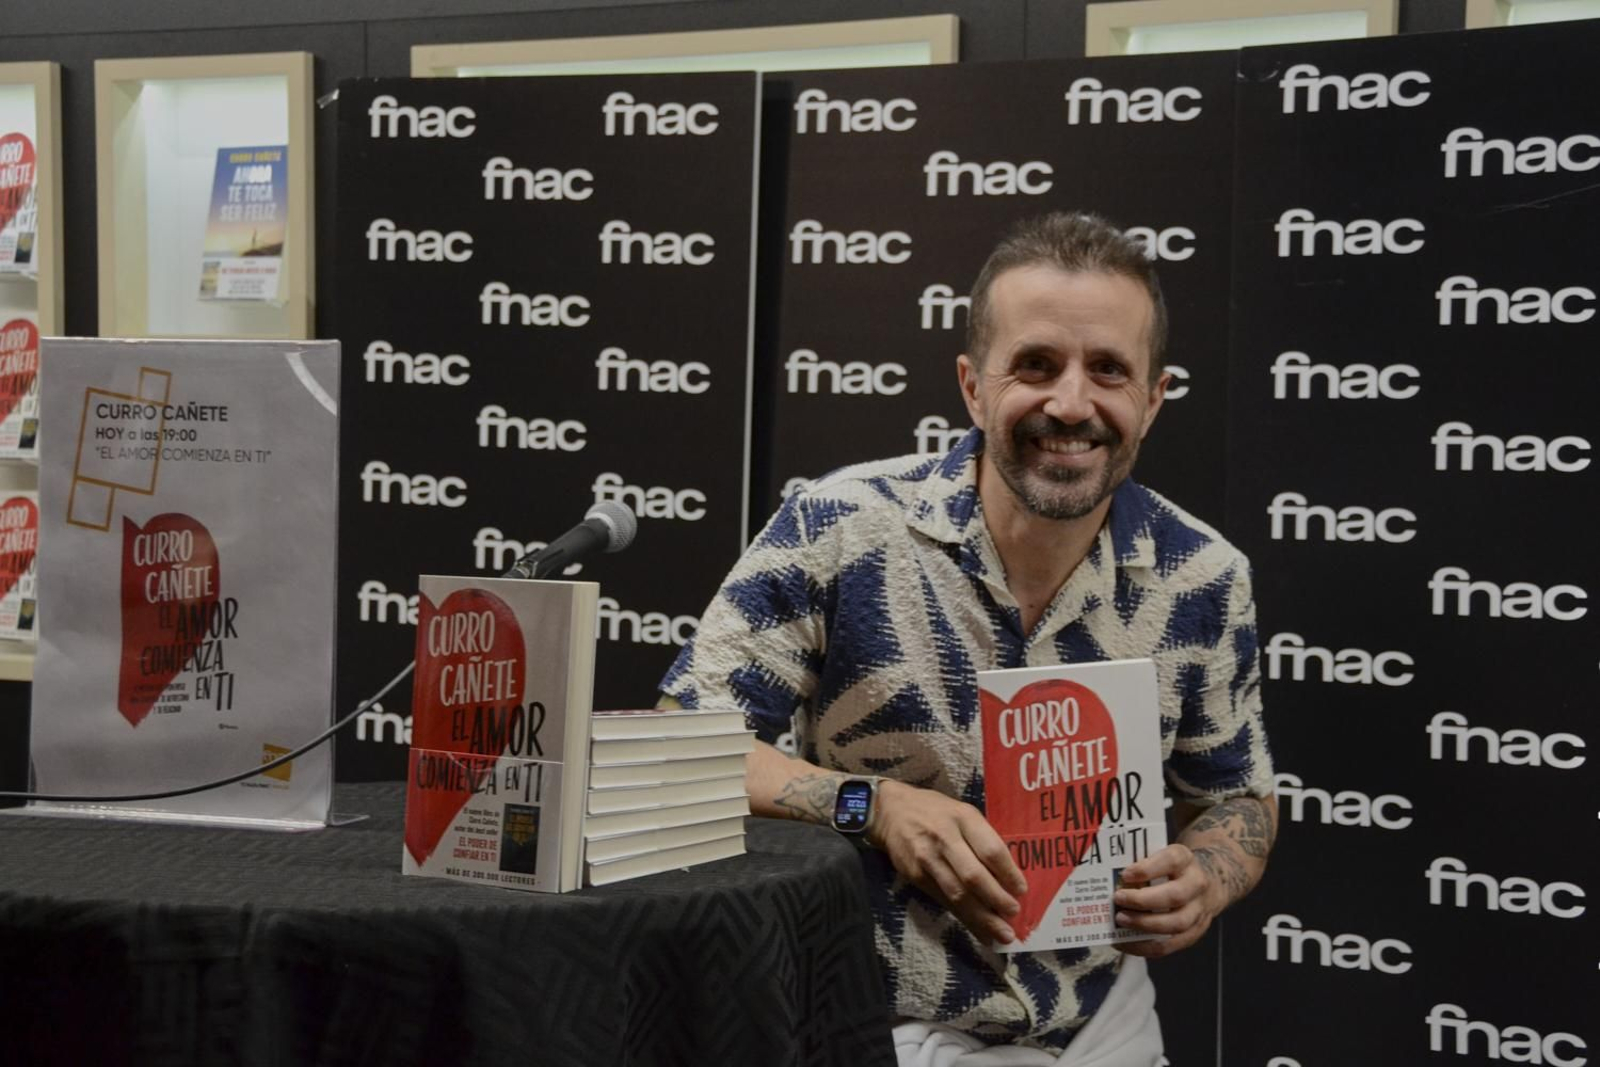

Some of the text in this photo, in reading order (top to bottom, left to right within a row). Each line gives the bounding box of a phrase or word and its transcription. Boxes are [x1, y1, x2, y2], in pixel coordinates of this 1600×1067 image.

[793, 88, 917, 134] fnac
[1064, 77, 1202, 125] fnac
[1279, 64, 1431, 114] fnac
[368, 95, 476, 138] fnac
[602, 91, 719, 136] fnac
[0, 162, 31, 188] AÑETE
[923, 150, 1053, 197] fnac
[1440, 127, 1600, 178] fnac
[482, 156, 594, 201] fnac
[366, 218, 473, 262] fnac
[598, 220, 715, 266] fnac
[789, 219, 912, 264] fnac
[1124, 226, 1196, 261] ac
[1274, 208, 1425, 257] fnac
[479, 282, 590, 327] fnac
[918, 285, 973, 330] fn
[1435, 275, 1596, 325] fnac
[363, 340, 470, 386] fnac
[595, 347, 711, 394] fnac
[784, 349, 907, 396] fnac
[1270, 351, 1420, 400] fnac
[96, 401, 228, 421] CURRO CAÑETE
[96, 427, 197, 441] HOY a las 19:00
[476, 405, 587, 452] fnac
[118, 447, 158, 461] AMOR
[162, 448, 230, 462] COMIENZA
[234, 449, 251, 463] EN
[1431, 421, 1591, 473] fnac
[360, 461, 467, 507] fnac
[1267, 492, 1417, 543] fnac
[133, 529, 193, 567] CURRO
[145, 563, 213, 604] CAÑETE
[1428, 567, 1588, 621] fnac
[159, 597, 239, 640] EL AMOR
[428, 610, 496, 658] CURRO
[140, 639, 225, 676] COMIENZA
[439, 655, 518, 707] CAÑETE
[1265, 632, 1414, 686] fnac
[195, 671, 234, 712] EN TI
[452, 701, 546, 757] EL AMOR
[999, 697, 1080, 748] CURRO
[1426, 711, 1586, 769] fnac
[416, 753, 543, 803] COMIENZA EN TI
[1019, 736, 1111, 791] CAÑETE
[1040, 771, 1144, 832] EL AMOR
[1109, 832, 1125, 857] EN
[1127, 827, 1148, 863] TI
[1425, 857, 1586, 919] fnac
[1262, 914, 1412, 974] fnac
[1425, 1003, 1587, 1067] fnac
